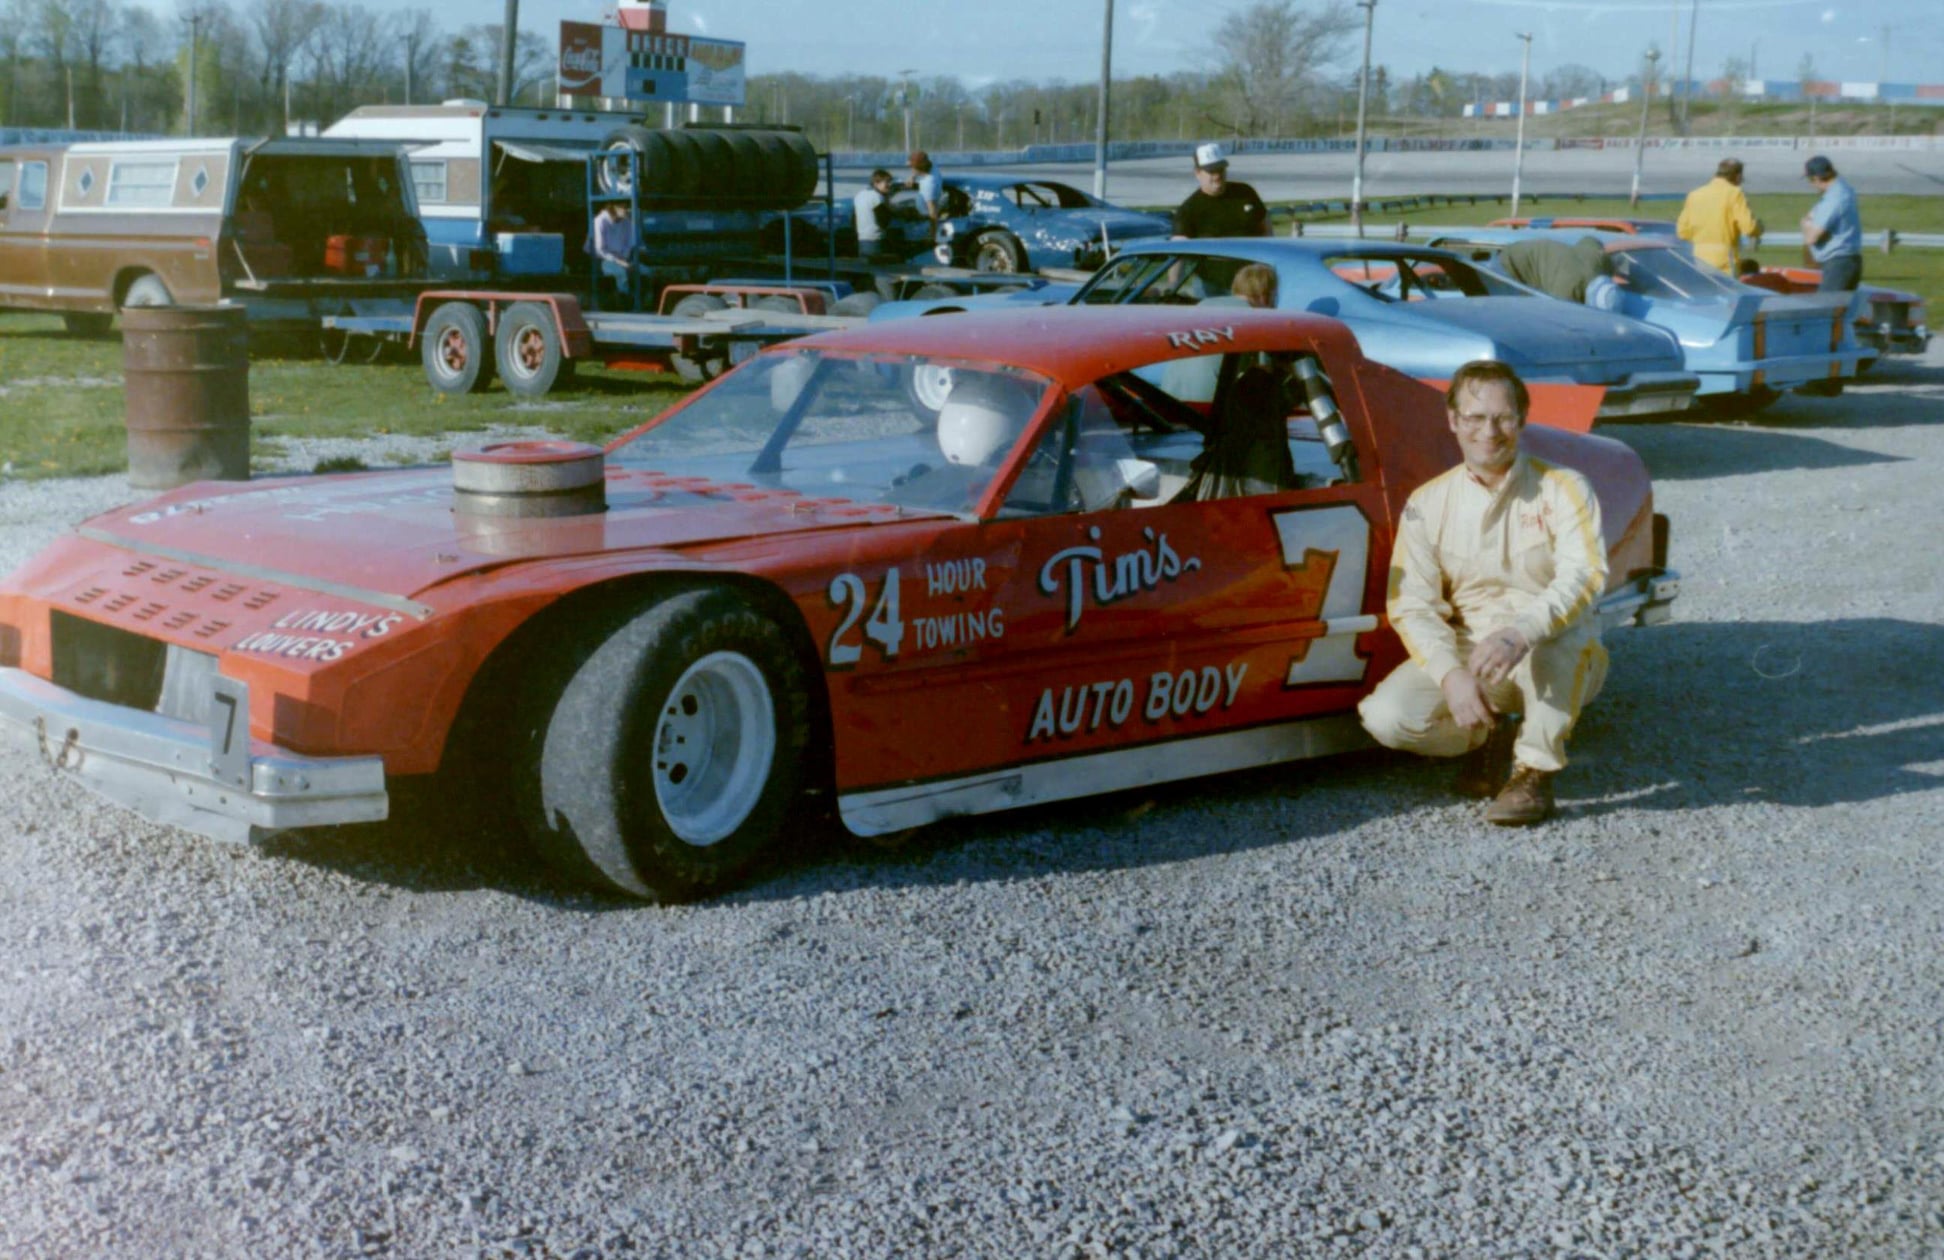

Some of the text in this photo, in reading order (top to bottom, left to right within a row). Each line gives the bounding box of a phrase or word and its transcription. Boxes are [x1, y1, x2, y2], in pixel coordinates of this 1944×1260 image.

[1166, 325, 1235, 351] RAY
[926, 556, 987, 597] HOUR
[1040, 525, 1200, 630] Tim's
[1272, 504, 1370, 687] 7
[272, 609, 403, 638] LINDY'S
[828, 566, 904, 665] 24
[912, 607, 1004, 651] TOWING
[214, 691, 238, 756] 7
[1029, 662, 1248, 740] AUTO BODY
